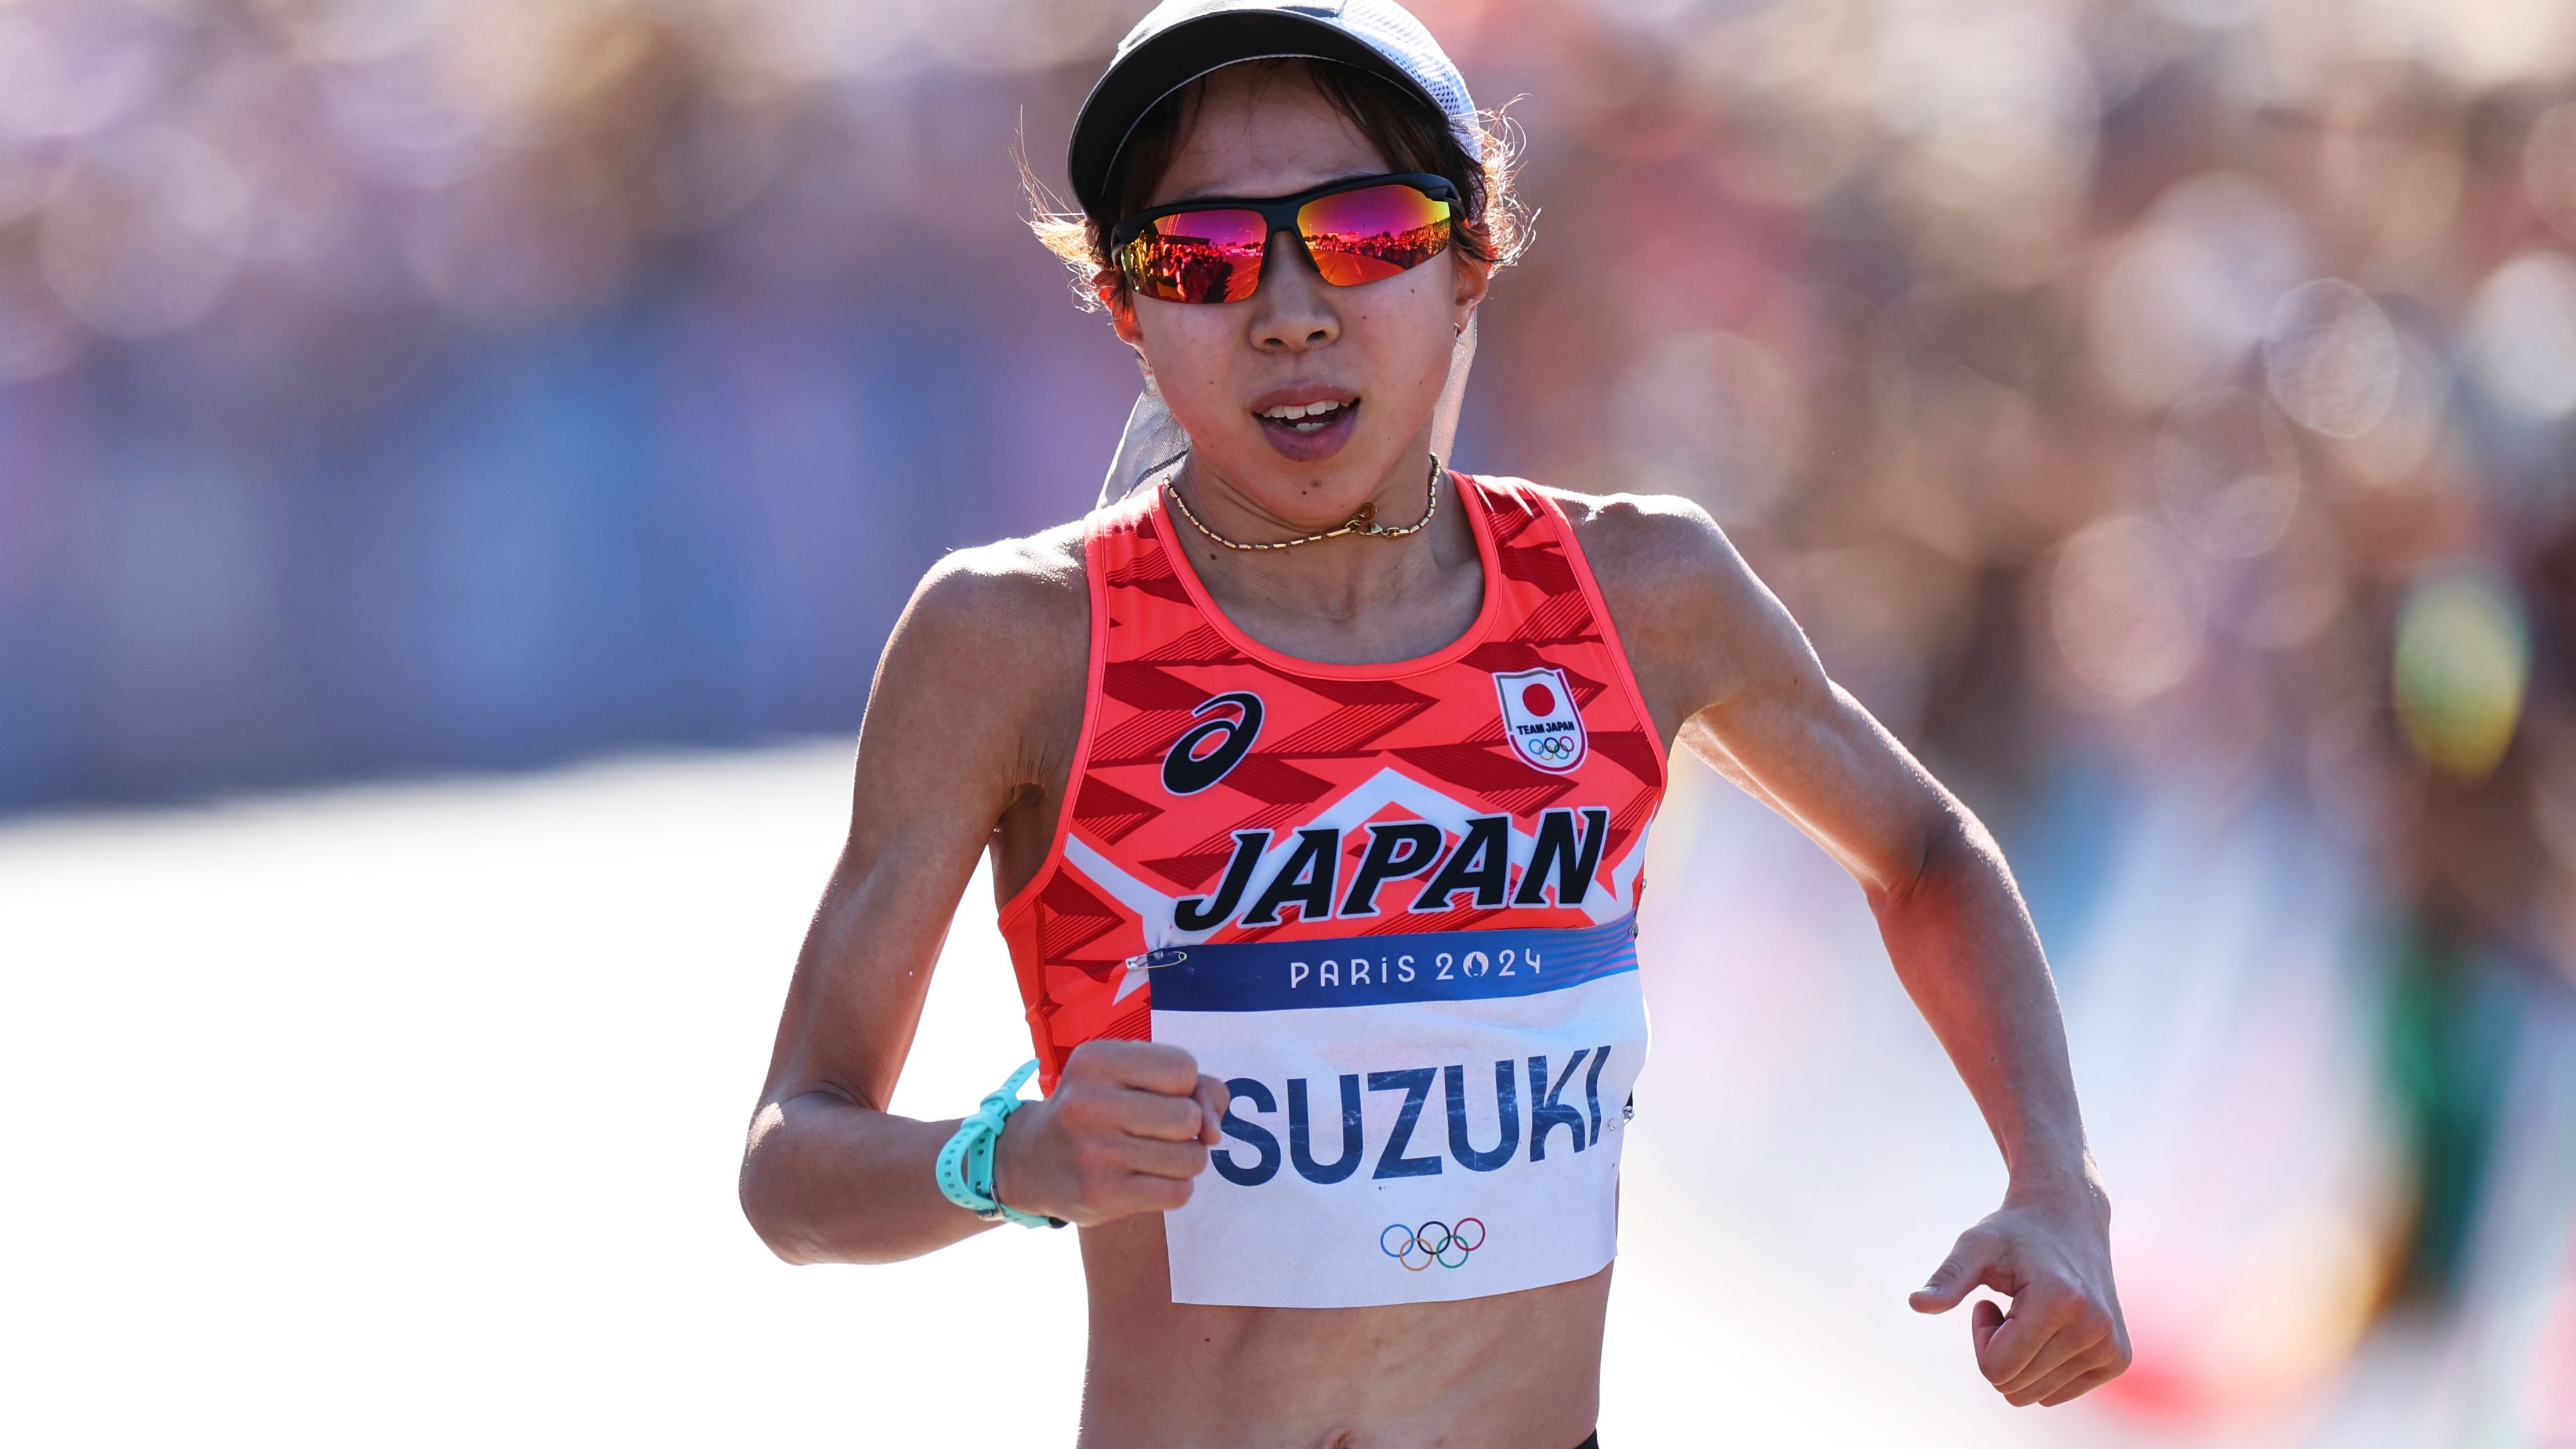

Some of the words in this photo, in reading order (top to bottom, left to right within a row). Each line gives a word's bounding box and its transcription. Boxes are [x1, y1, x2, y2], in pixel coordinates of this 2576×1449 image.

[1517, 724, 1545, 735] TEAM
[1546, 721, 1575, 732] JAPAN
[1173, 806, 1609, 932] JAPAN
[1435, 948, 1542, 980] 2024
[1210, 1045, 1611, 1186] SUZUKI
